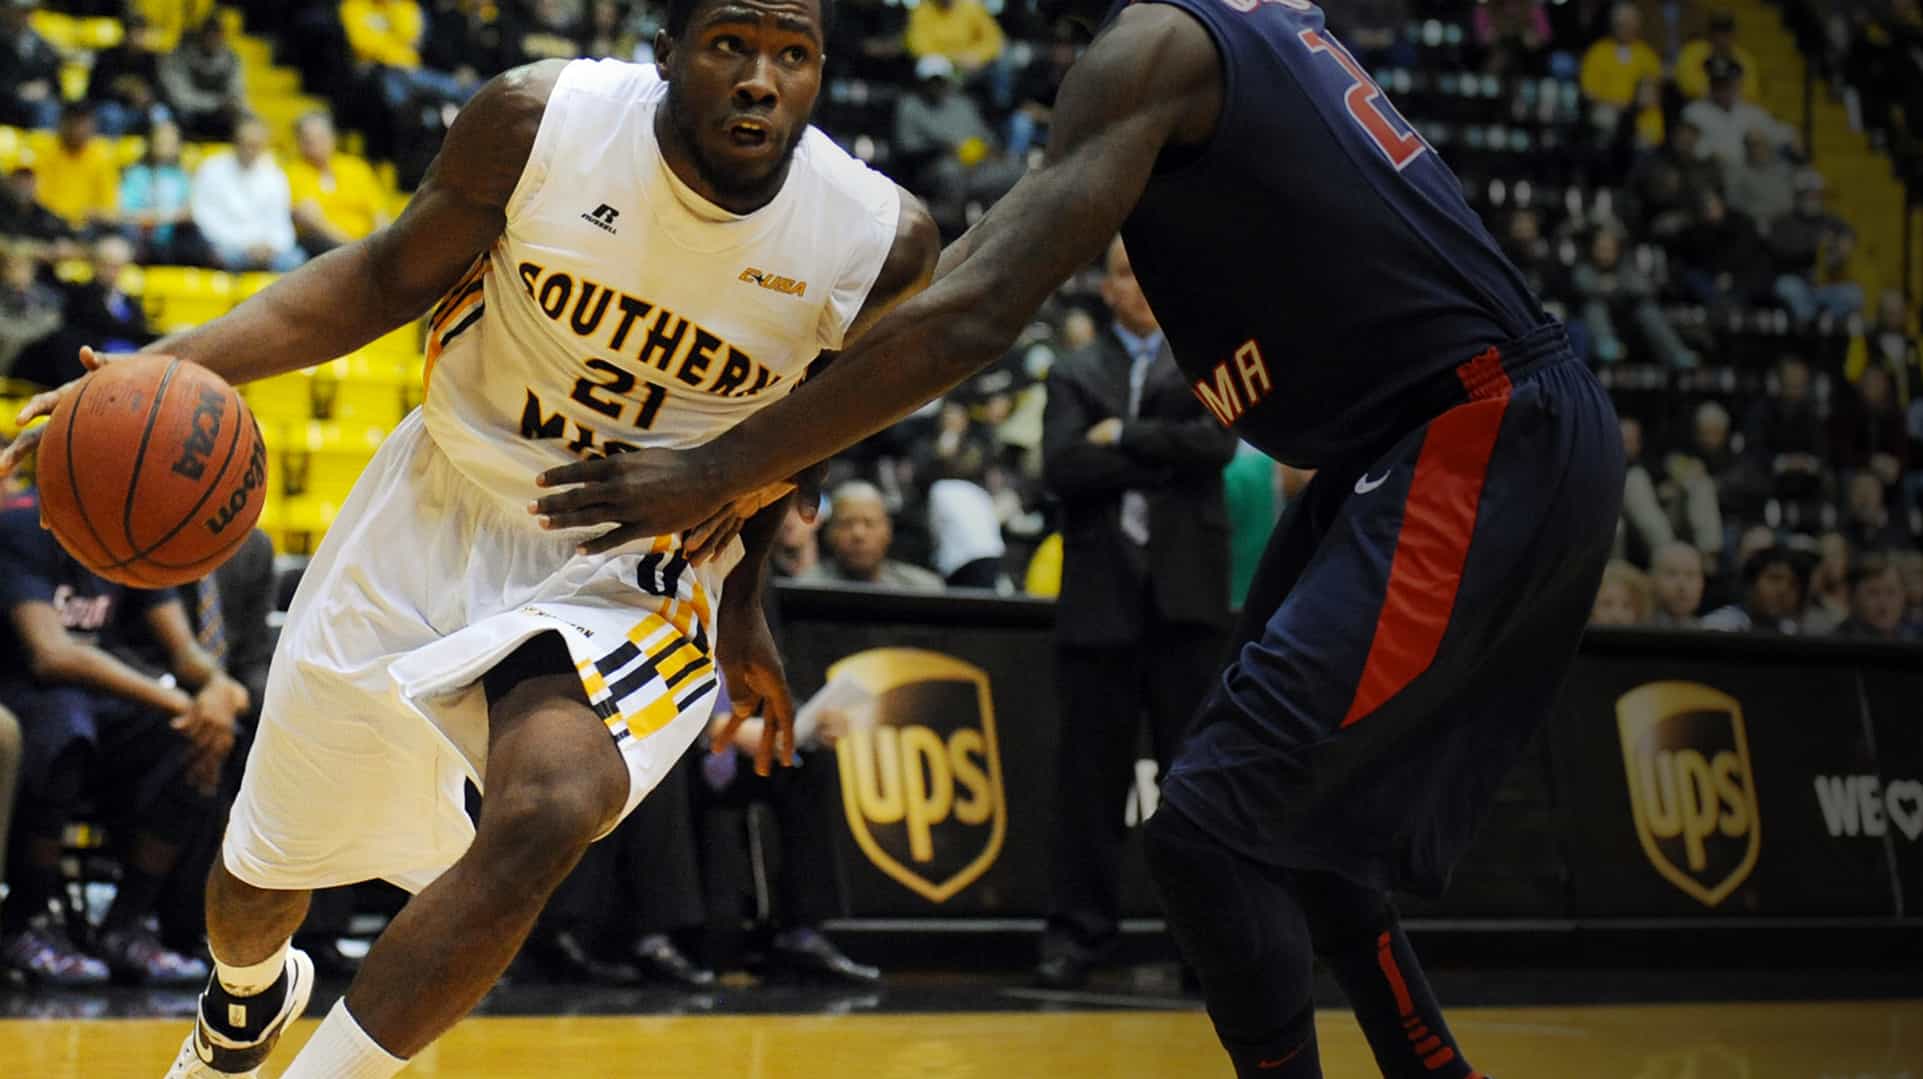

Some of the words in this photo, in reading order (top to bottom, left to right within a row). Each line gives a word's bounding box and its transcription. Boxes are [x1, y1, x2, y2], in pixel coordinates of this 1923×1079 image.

[1298, 28, 1437, 171] 2
[570, 357, 669, 431] 21
[851, 723, 994, 863] ups
[1637, 750, 1752, 871] ups
[1813, 774, 1888, 837] WE
